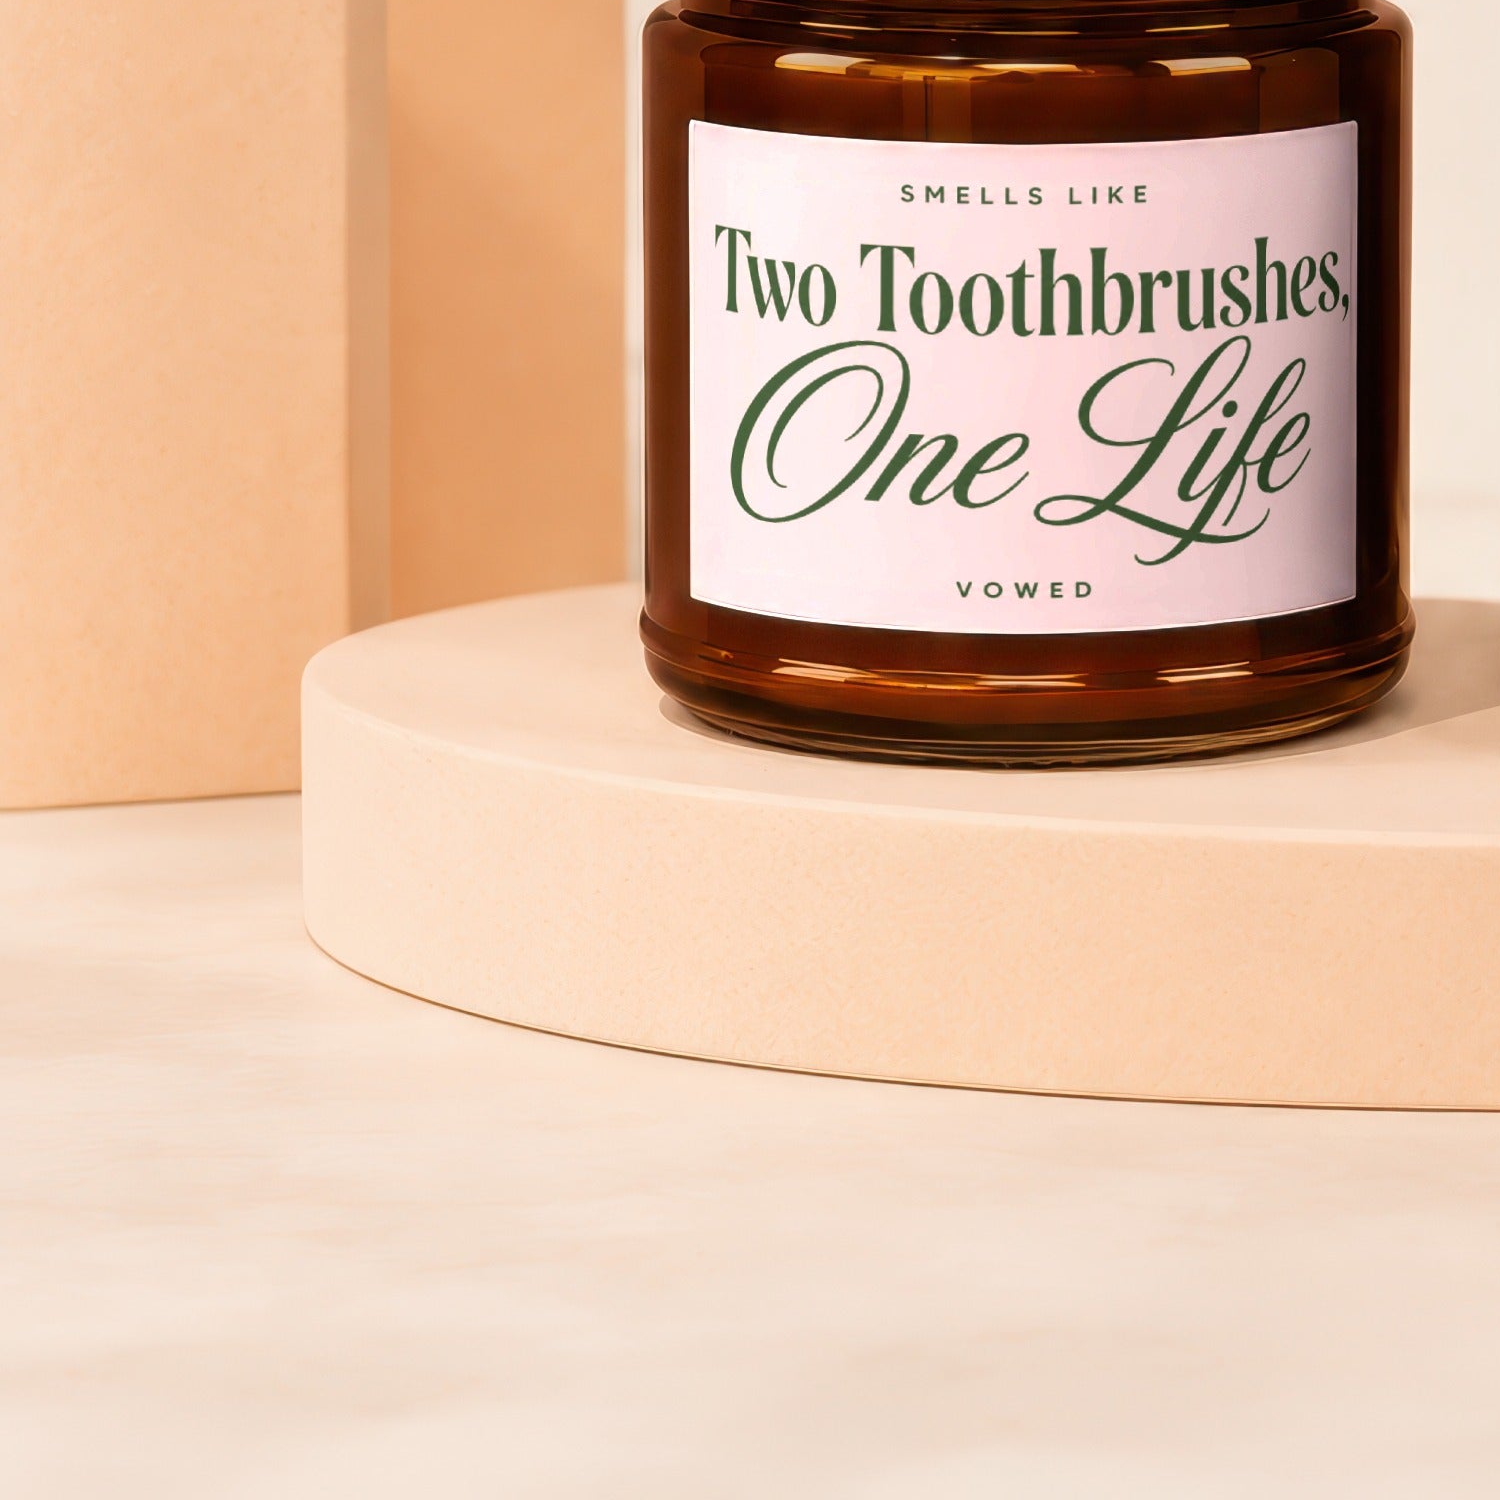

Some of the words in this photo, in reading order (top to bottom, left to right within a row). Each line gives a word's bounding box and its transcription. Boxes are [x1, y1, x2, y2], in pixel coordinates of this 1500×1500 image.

[899, 183, 1045, 207] SMELLS
[1067, 184, 1149, 206] LIKE
[713, 224, 838, 327] Two
[859, 236, 1350, 337] Toothbrushes,
[730, 339, 1030, 524] One
[1034, 335, 1312, 567] Life
[955, 580, 1094, 600] VOWED
